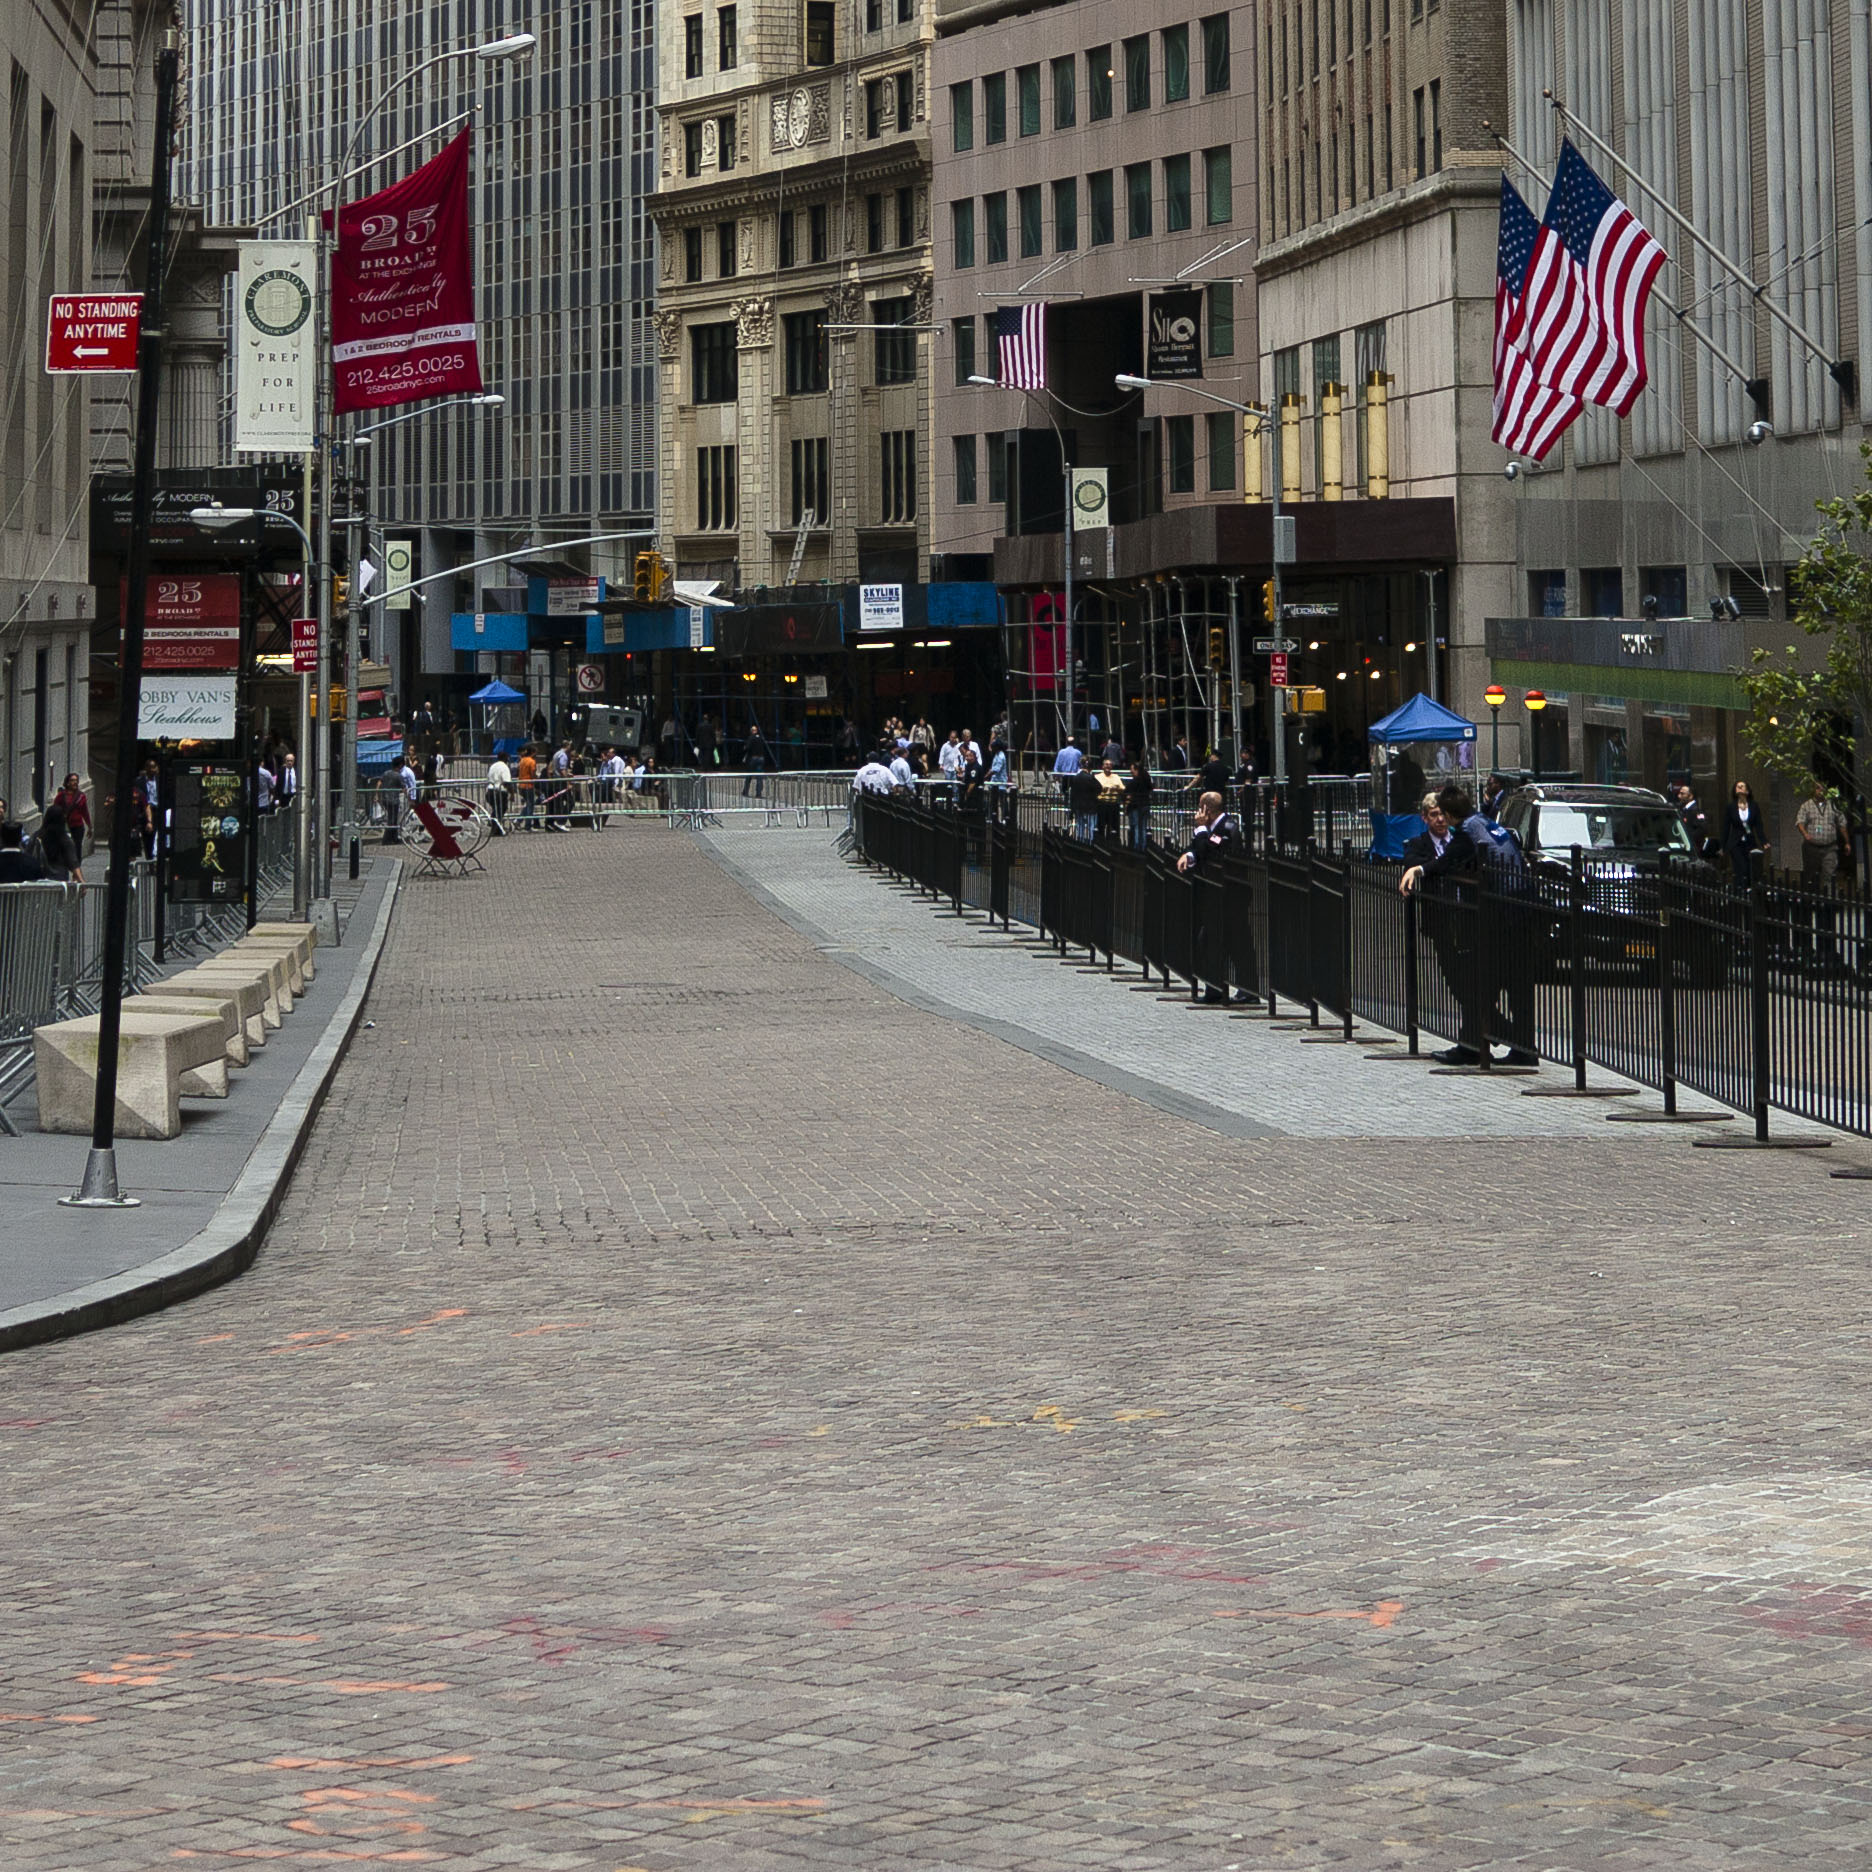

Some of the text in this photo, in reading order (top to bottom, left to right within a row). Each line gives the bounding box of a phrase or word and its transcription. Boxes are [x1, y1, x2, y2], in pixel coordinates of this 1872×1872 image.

[360, 203, 440, 252] 25
[358, 271, 371, 280] AT
[372, 269, 390, 279] THE
[246, 270, 310, 300] CLAREMONT
[55, 302, 138, 319] NO STANDING
[360, 299, 439, 325] MODERN
[64, 323, 128, 339] ANYTIME
[365, 337, 414, 352] BEDROOM
[417, 329, 462, 342] RENTALS
[258, 353, 300, 362] PREP
[347, 354, 465, 387] 212.425.0025
[262, 378, 294, 387] FOR
[366, 374, 446, 395] 25broadnyc.com
[259, 403, 297, 412] LIFE
[169, 493, 215, 503] MODERN
[265, 489, 295, 511] 25
[158, 581, 202, 603] 25
[863, 587, 900, 597] SKYLINE
[303, 624, 316, 636] NO
[143, 646, 216, 657] 212.425.0025
[139, 690, 232, 703] OBBY VAN'S
[138, 704, 222, 725] Steakhouse
